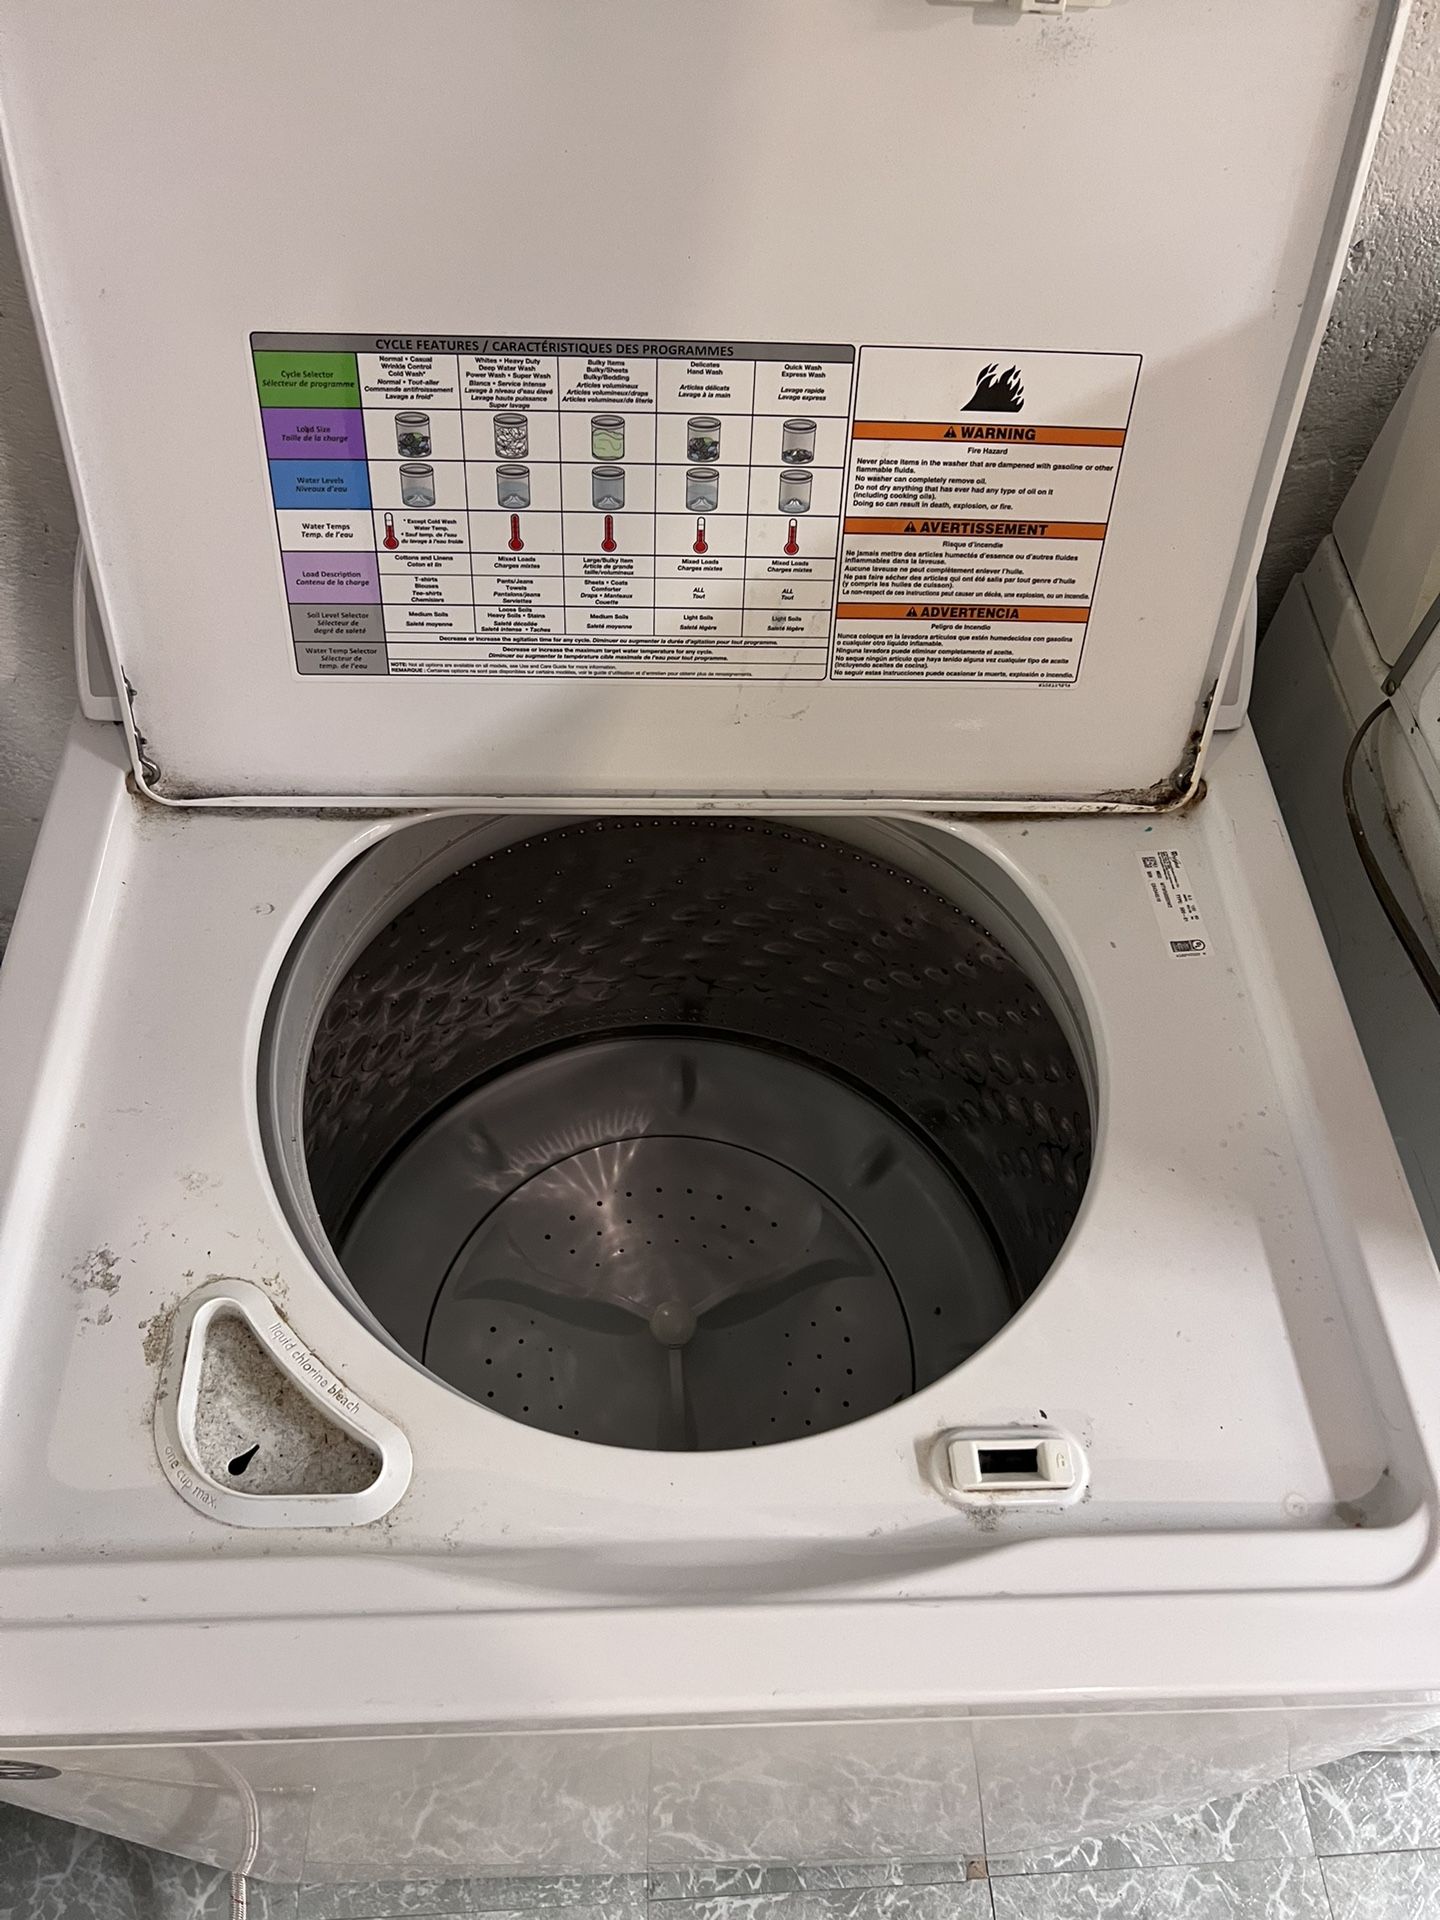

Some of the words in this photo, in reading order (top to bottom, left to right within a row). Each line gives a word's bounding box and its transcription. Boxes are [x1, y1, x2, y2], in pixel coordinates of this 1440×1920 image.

[375, 340, 412, 350] CYCLE
[416, 340, 478, 351] FEATURES
[492, 340, 612, 354] CARACTÉRISTIQUES
[616, 344, 638, 354] DES
[642, 344, 734, 356] PROGRAMMES
[587, 359, 605, 367] Bulky
[280, 371, 301, 379] Cycle
[781, 371, 806, 379] Express
[780, 387, 803, 395] Lavage
[804, 387, 824, 395] rapide
[778, 394, 800, 402] Lavage
[961, 427, 1036, 440] WARNING
[323, 435, 348, 443] charge
[879, 458, 898, 467] place
[997, 462, 1034, 471] dampened
[1052, 463, 1083, 472] gasoline
[908, 476, 946, 485] completely
[879, 484, 890, 493] dry
[892, 485, 923, 494] anything
[1000, 487, 1016, 496] type
[853, 492, 888, 501] (including
[889, 492, 918, 501] cooking
[919, 493, 937, 502] oils).
[853, 500, 873, 509] Doing
[929, 502, 951, 511] death,
[952, 502, 988, 511] explosion,
[326, 523, 350, 532] Temps
[920, 522, 1048, 535] AVERTISSEMENT
[301, 531, 322, 540] Temp.
[942, 541, 966, 549] Risque
[321, 571, 361, 580] Description
[345, 579, 369, 588] charge
[920, 607, 1019, 618] ADVERTENCIA
[269, 1322, 296, 1351] liquid
[291, 1350, 328, 1387] chlorine
[326, 1383, 360, 1414] bleach
[165, 1446, 179, 1469] one
[176, 1470, 193, 1489] cup
[192, 1486, 216, 1509] max.
